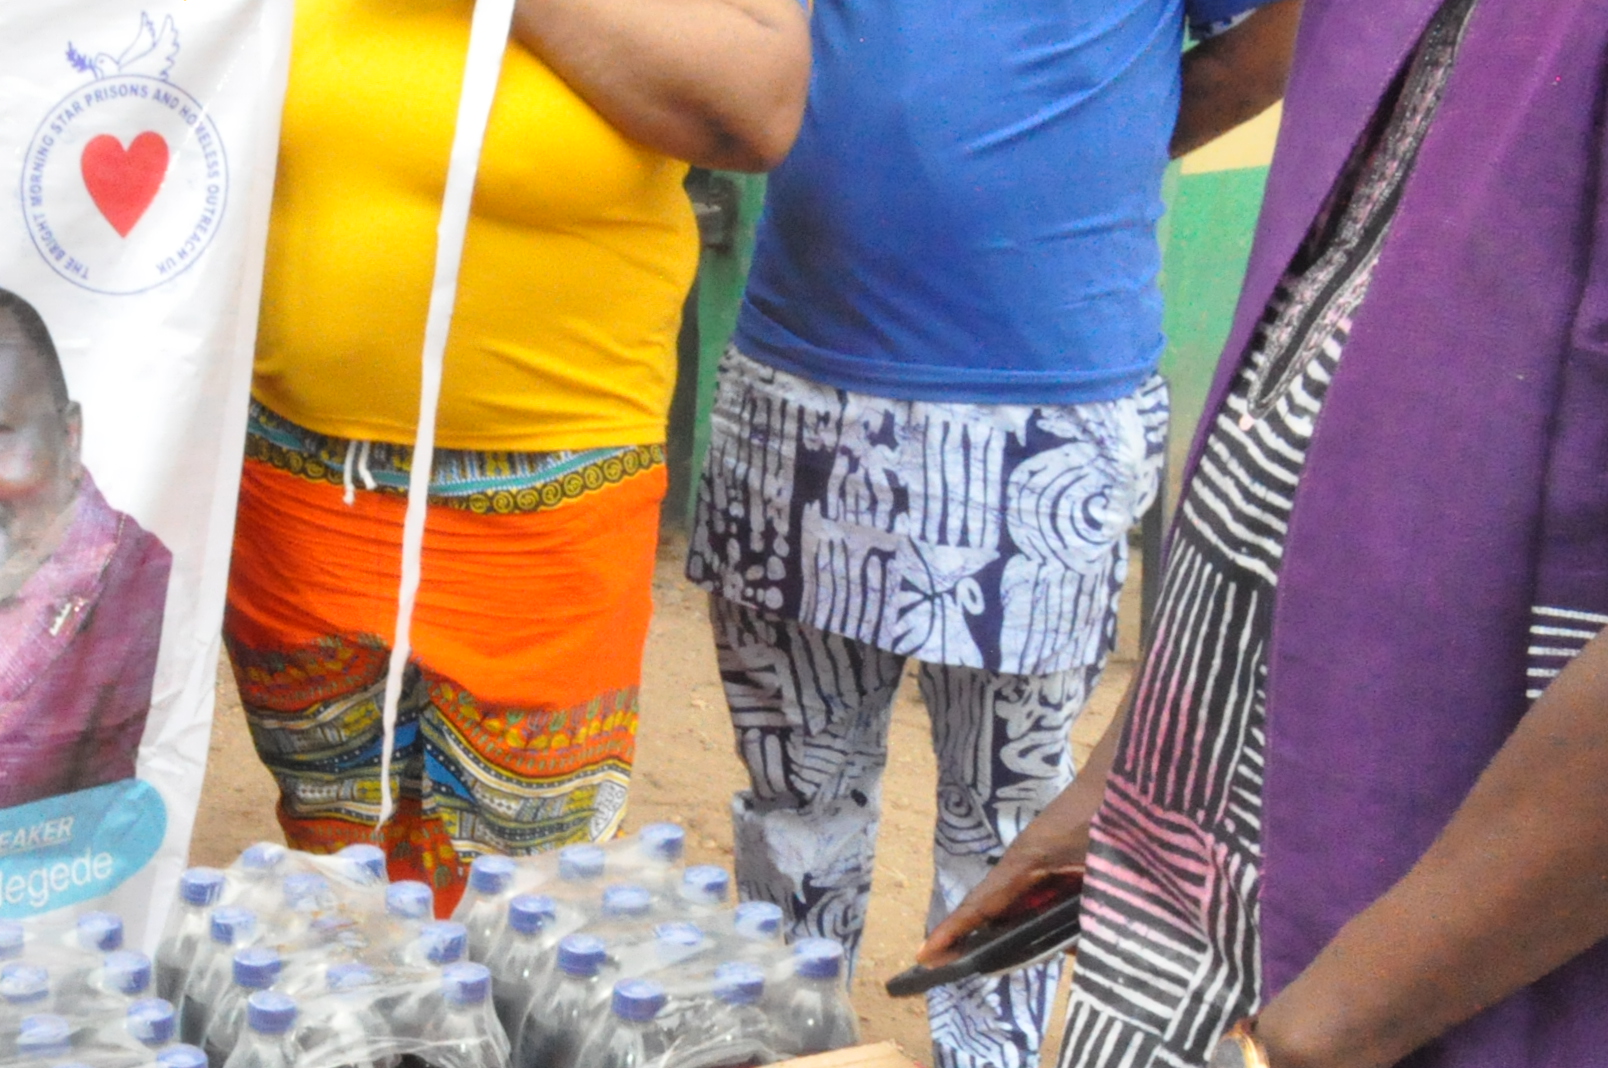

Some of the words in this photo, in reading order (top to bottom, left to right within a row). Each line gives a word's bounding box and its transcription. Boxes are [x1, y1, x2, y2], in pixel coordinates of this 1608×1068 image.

[84, 83, 149, 107] PRISONS
[152, 88, 180, 110] AND
[50, 101, 84, 135] STAR
[30, 134, 55, 207] MORNING
[176, 184, 220, 260] OUTREACH
[33, 213, 66, 262] BRIGHT
[64, 257, 89, 280] THE
[156, 257, 177, 276] UK
